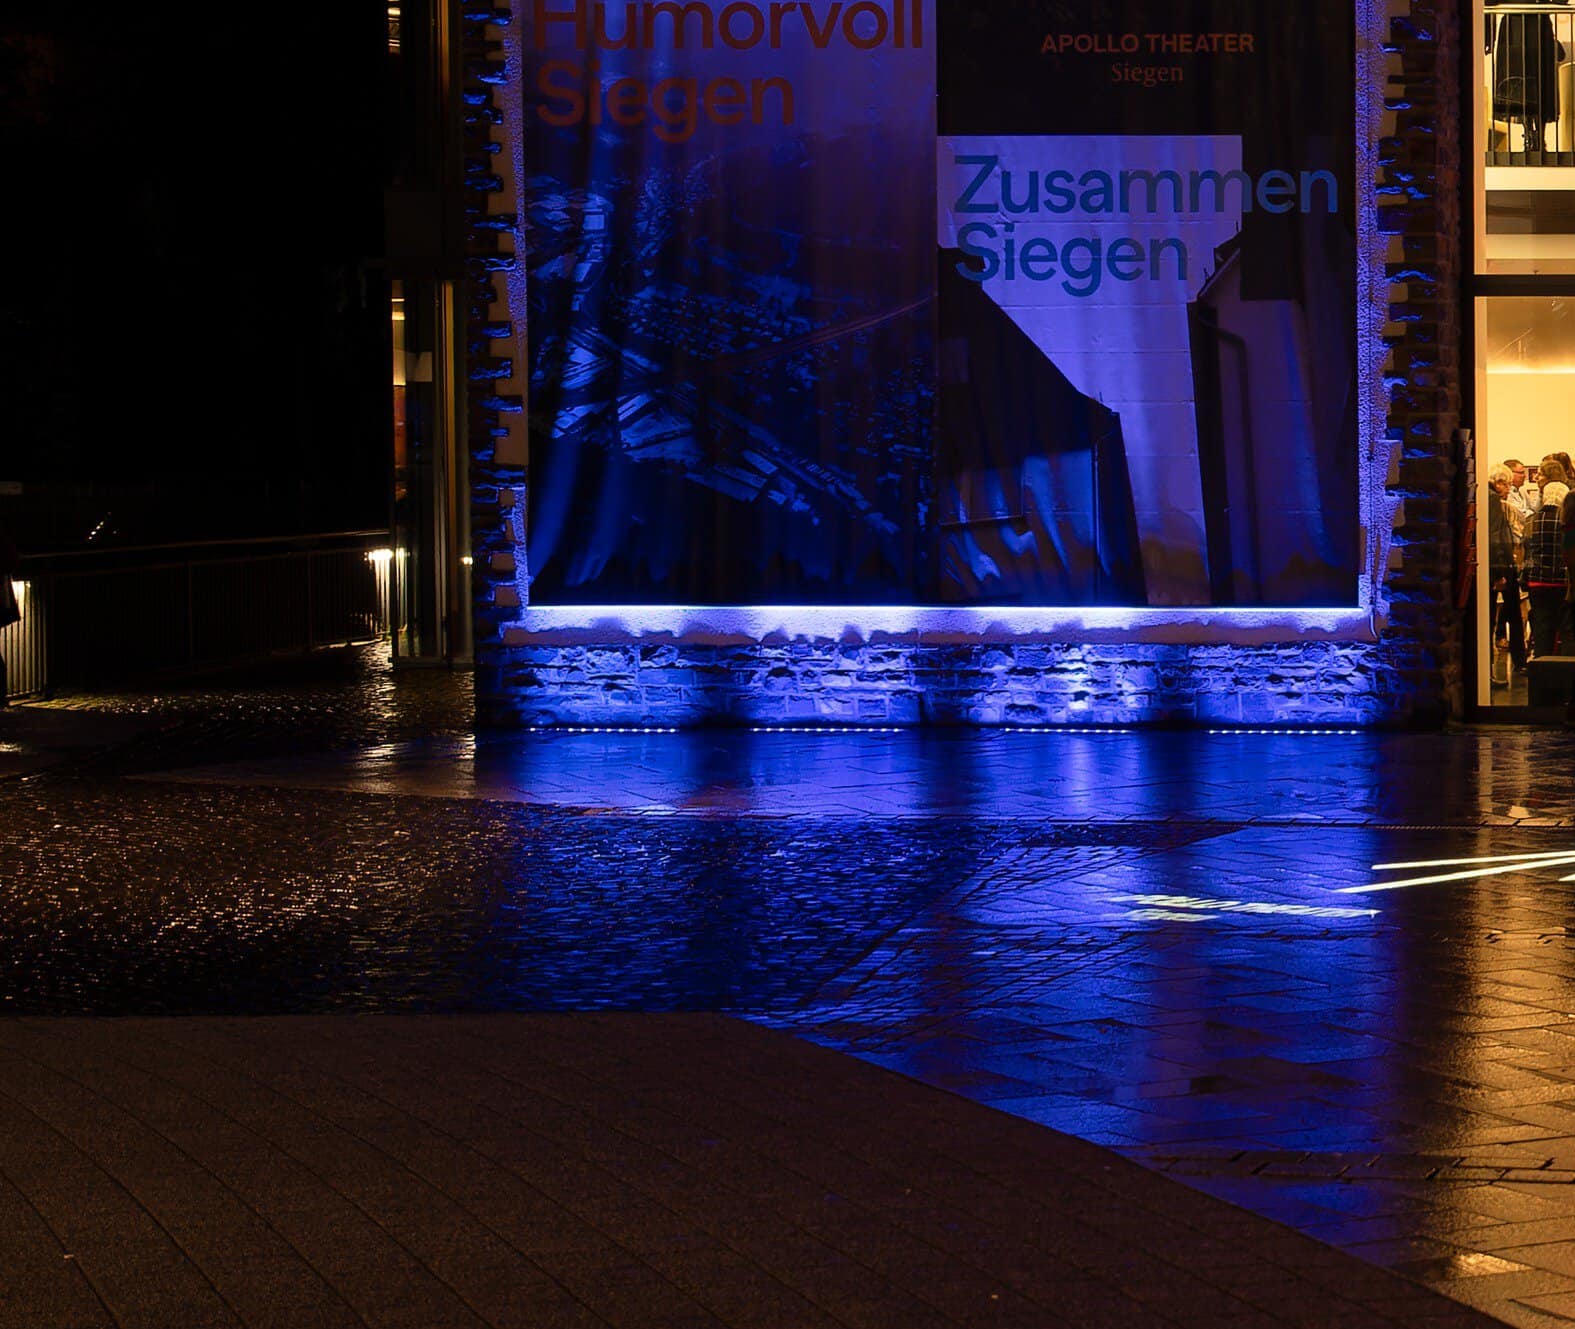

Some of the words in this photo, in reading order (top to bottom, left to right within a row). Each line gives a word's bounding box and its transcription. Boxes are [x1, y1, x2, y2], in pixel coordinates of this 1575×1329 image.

[1041, 32, 1139, 54] APOLLO
[1145, 32, 1255, 54] THEATER
[535, 61, 794, 143] Siegen
[1111, 61, 1185, 87] Siegen
[953, 155, 1339, 215] Zusammen
[957, 223, 1188, 297] Siegen
